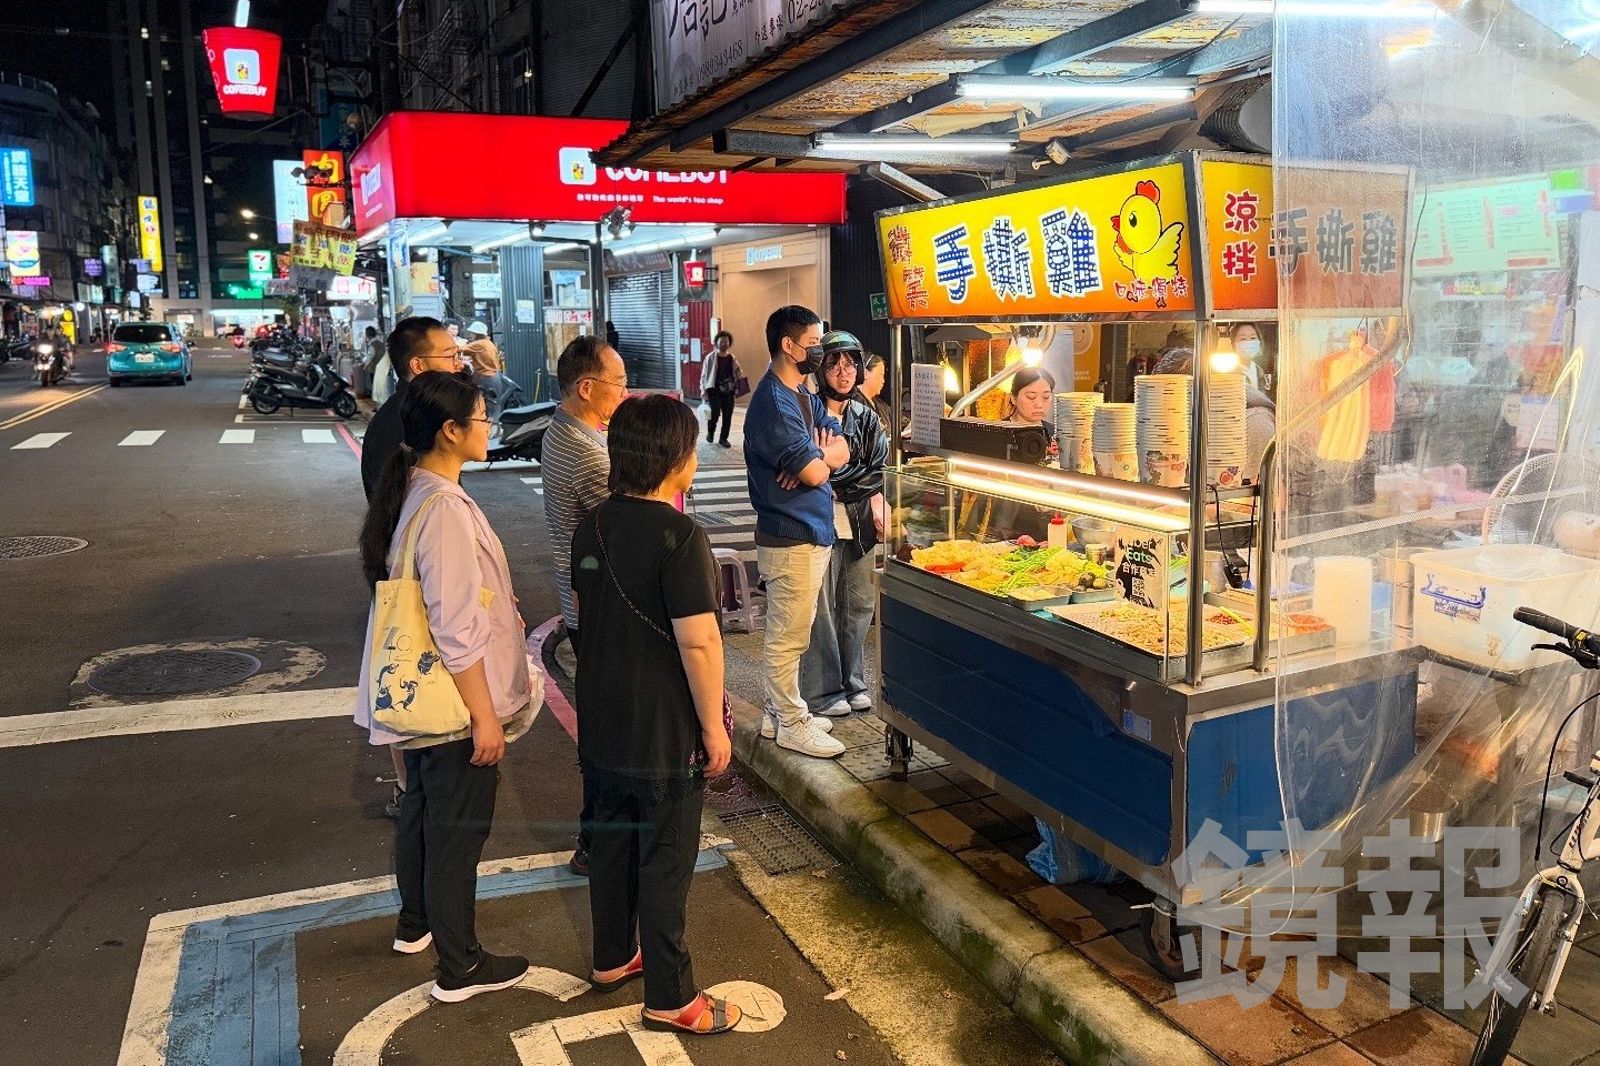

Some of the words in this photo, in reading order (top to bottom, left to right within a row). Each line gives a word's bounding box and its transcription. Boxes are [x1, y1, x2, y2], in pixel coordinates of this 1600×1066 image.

[933, 207, 1103, 303] 手撕雞
[1223, 190, 1258, 283] 涼拌
[1269, 207, 1398, 277] 手撕雞
[1127, 546, 1153, 564] Eats
